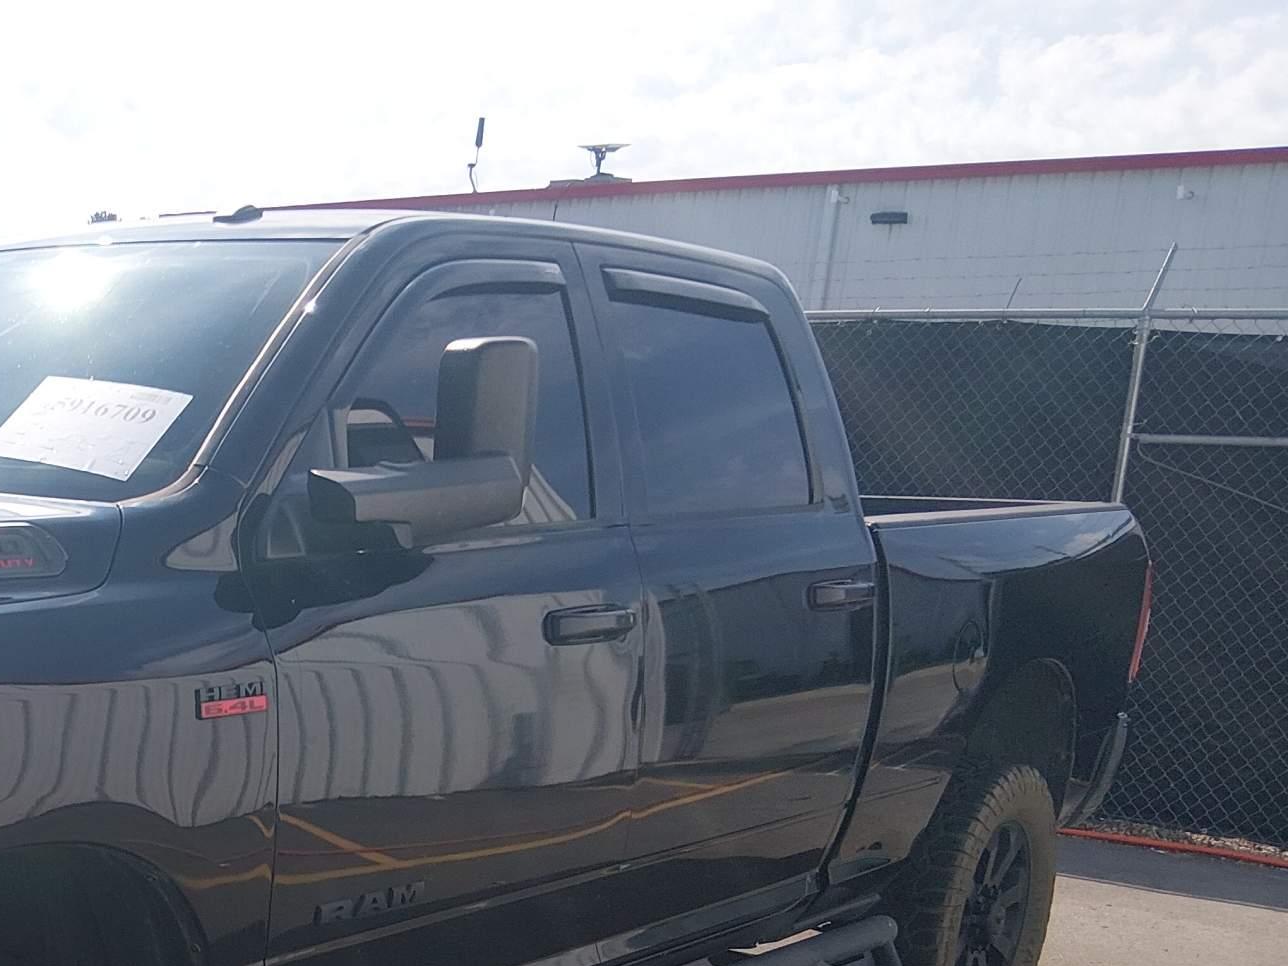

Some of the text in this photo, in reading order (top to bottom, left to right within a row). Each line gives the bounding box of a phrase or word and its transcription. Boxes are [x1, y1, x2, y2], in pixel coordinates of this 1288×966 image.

[42, 395, 157, 424] 5916709
[204, 699, 265, 717] 6.4L
[314, 881, 425, 926] RAM
